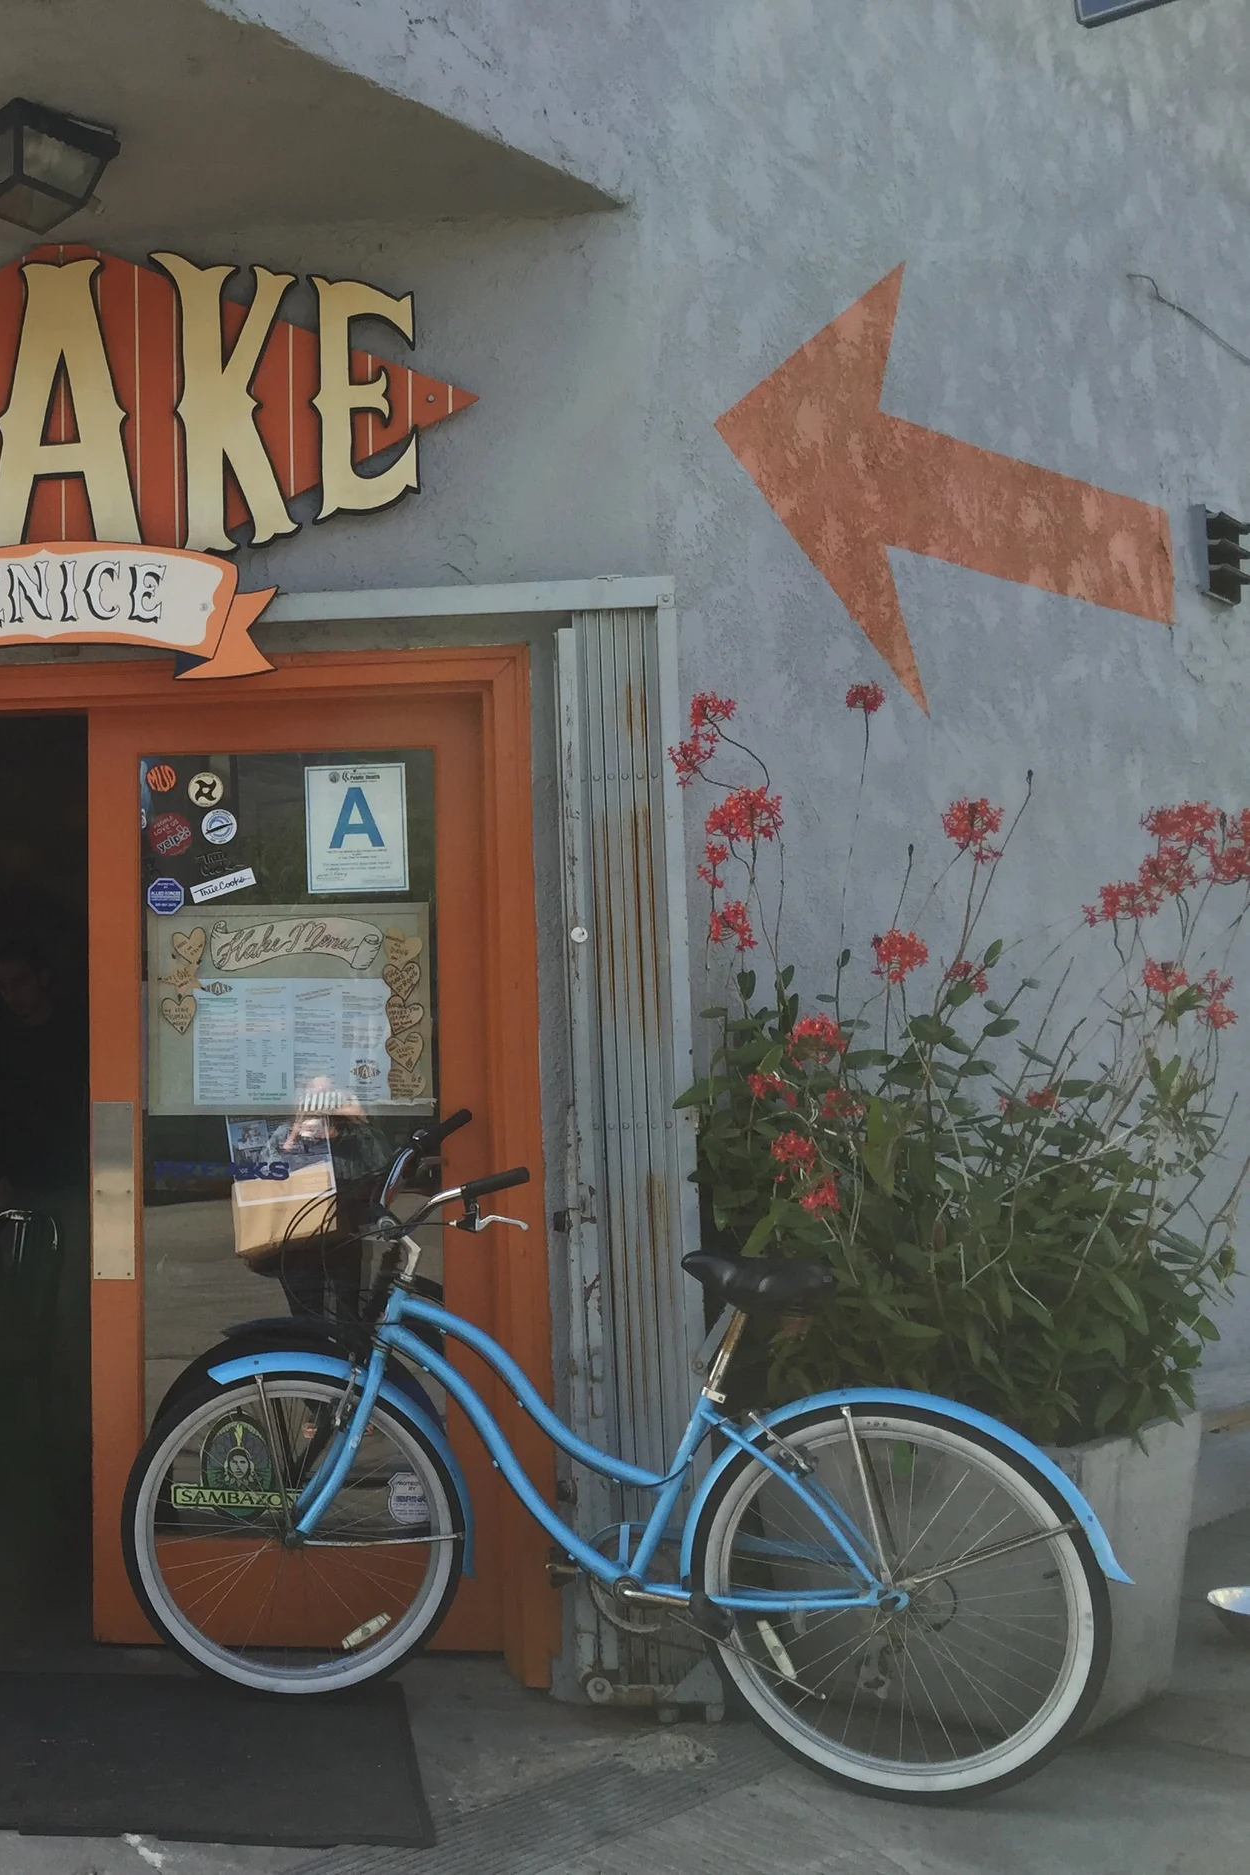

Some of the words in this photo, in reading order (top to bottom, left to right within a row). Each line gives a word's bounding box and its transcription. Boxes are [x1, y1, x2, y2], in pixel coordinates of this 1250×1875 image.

[147, 765, 176, 792] MUD
[329, 786, 385, 849] A
[153, 823, 171, 837] LOVE
[156, 834, 181, 854] yelp
